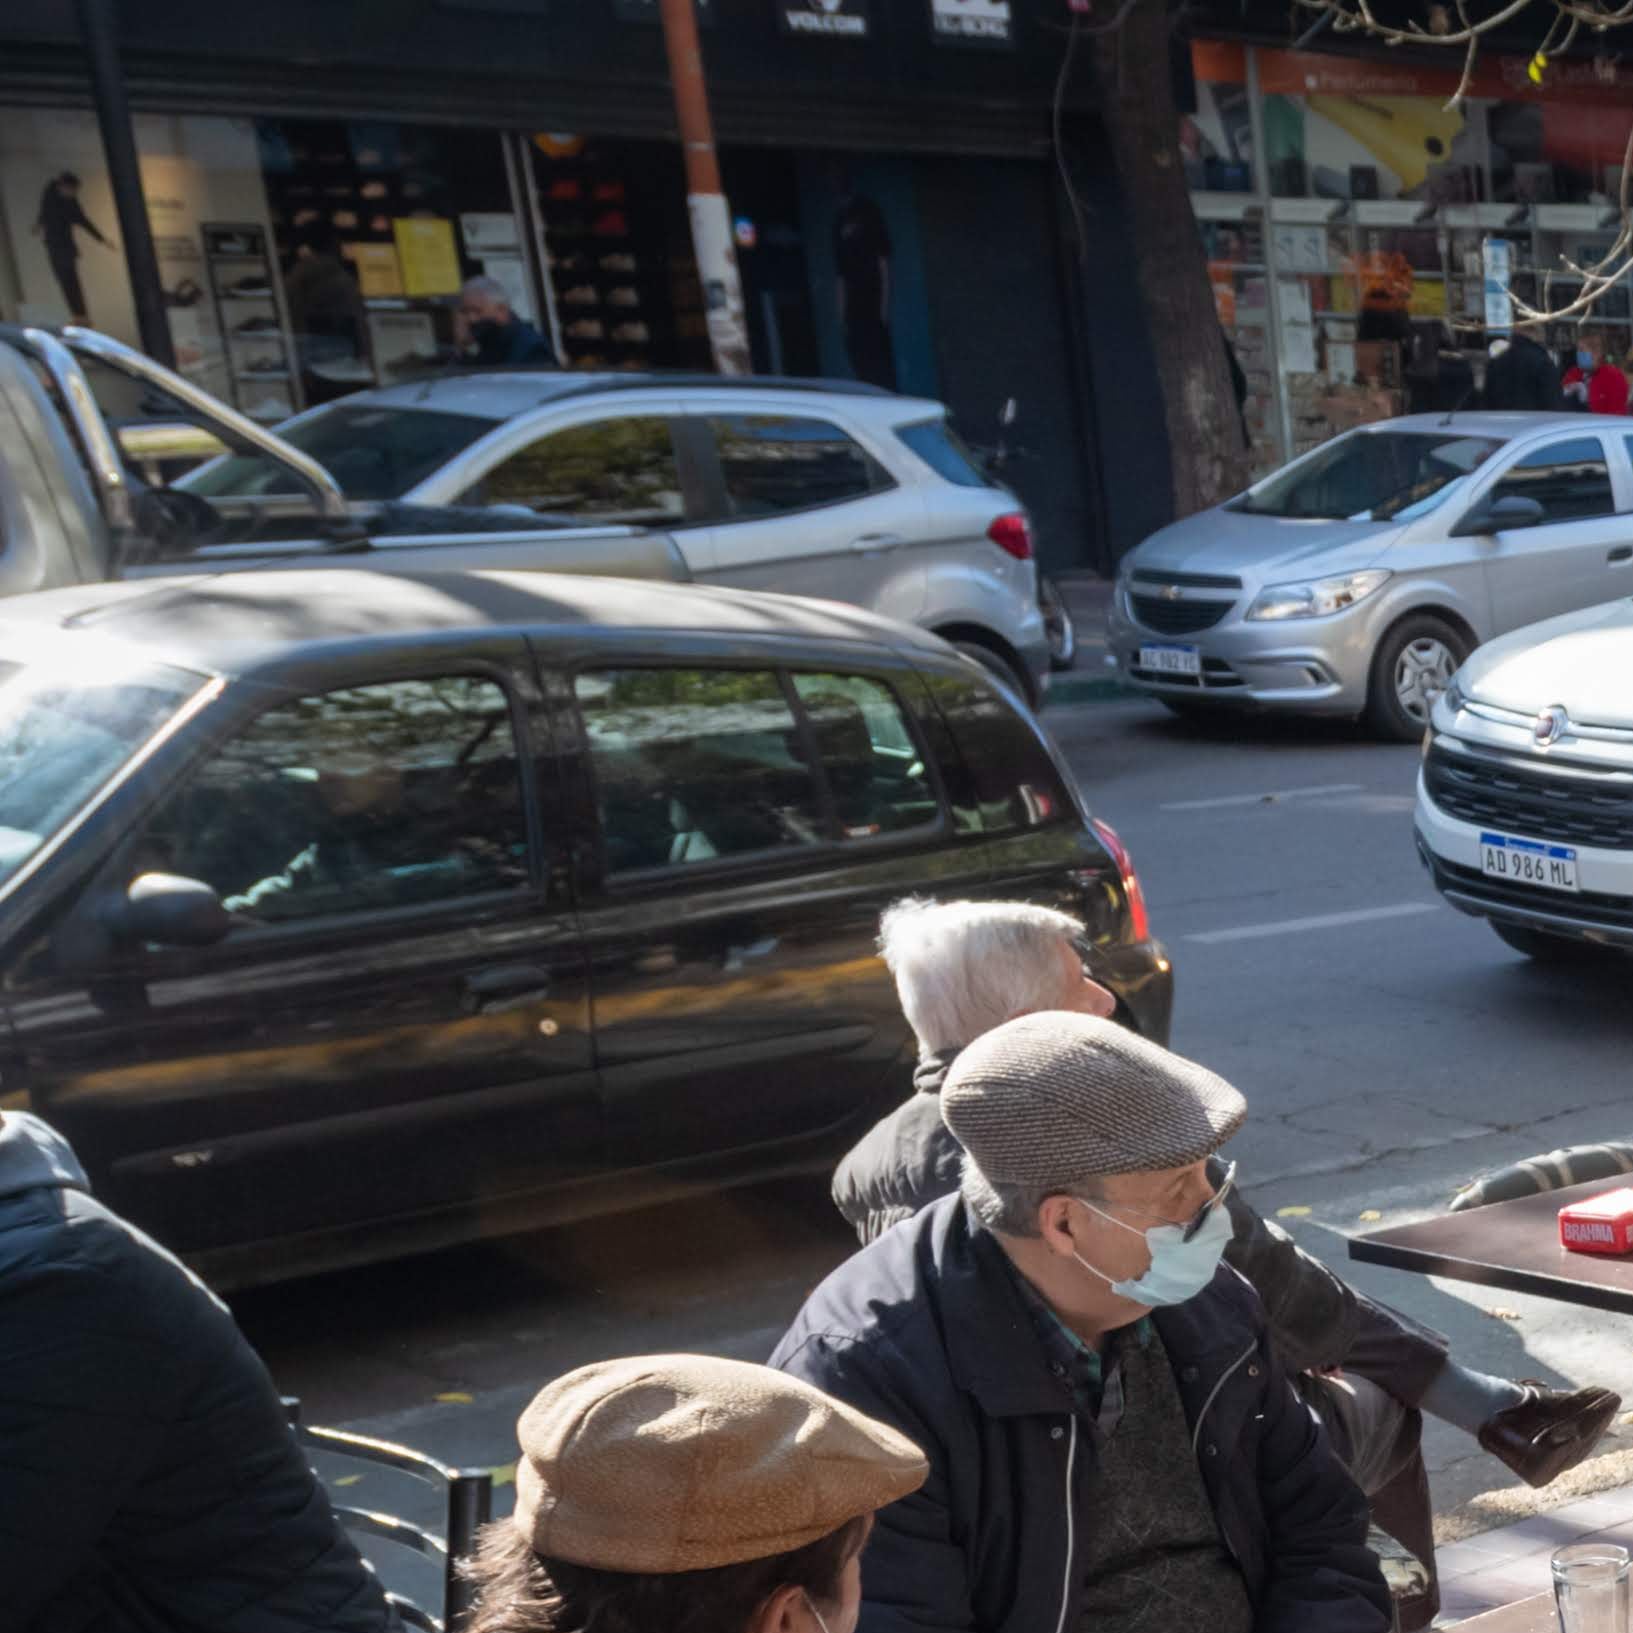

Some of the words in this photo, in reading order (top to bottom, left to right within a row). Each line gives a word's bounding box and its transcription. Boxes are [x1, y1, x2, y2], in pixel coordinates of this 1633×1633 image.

[1487, 848, 1506, 873] AD
[1512, 853, 1544, 880] 986
[1550, 861, 1573, 886] ML
[1563, 1222, 1615, 1243] BRAHMA
